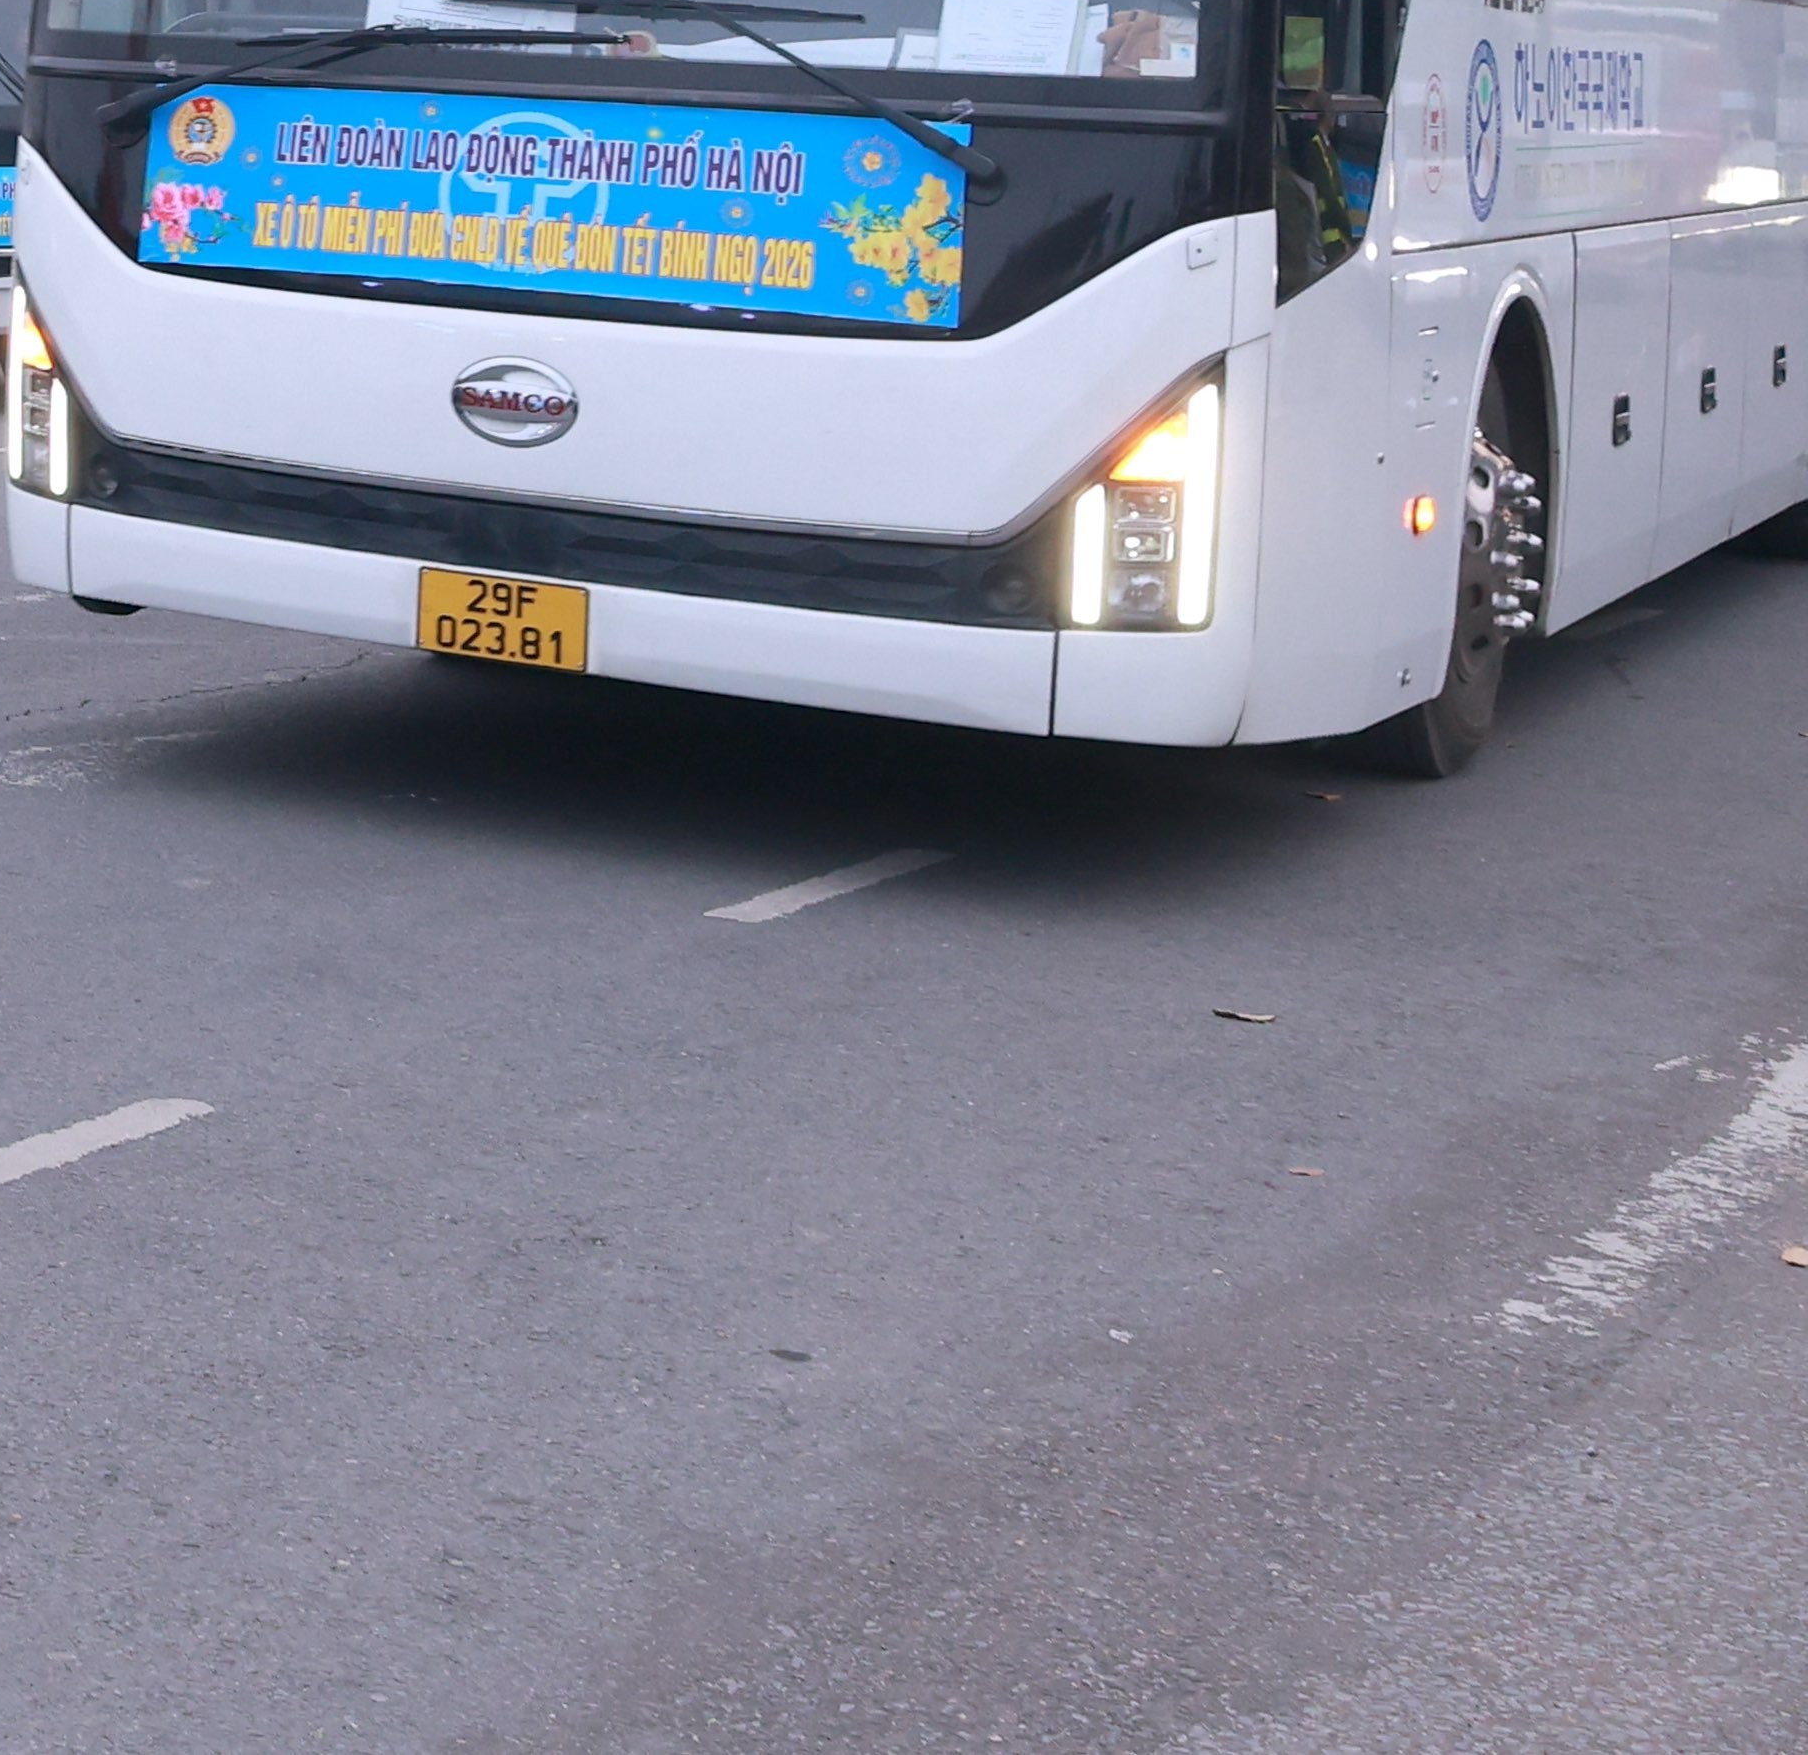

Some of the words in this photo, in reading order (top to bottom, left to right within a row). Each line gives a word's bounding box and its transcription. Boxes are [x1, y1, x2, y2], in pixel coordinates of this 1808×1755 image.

[277, 115, 330, 164] LIÊN
[337, 119, 406, 169] ĐOÀN
[412, 130, 459, 172] LAO
[466, 126, 536, 183] ĐỘNG
[548, 130, 635, 185] THÀNH
[641, 130, 704, 188] PHỐ
[706, 138, 743, 192] HÀ
[753, 142, 805, 205] NỘI
[254, 201, 278, 247] XE
[280, 193, 296, 248] Ô
[298, 194, 319, 250] TÔ
[322, 190, 370, 253] MIỄN
[373, 201, 409, 256] PHÍ
[504, 203, 531, 265] VỀ
[533, 212, 572, 273] QUÊ
[575, 213, 617, 273] ĐÓN
[622, 212, 657, 276] TẾT
[659, 219, 710, 281] BÍNH
[714, 233, 758, 296] NGỌ
[761, 237, 815, 290] 2026
[460, 386, 567, 416] SAMCO
[467, 579, 539, 619] 29F
[437, 614, 563, 664] 023.81
